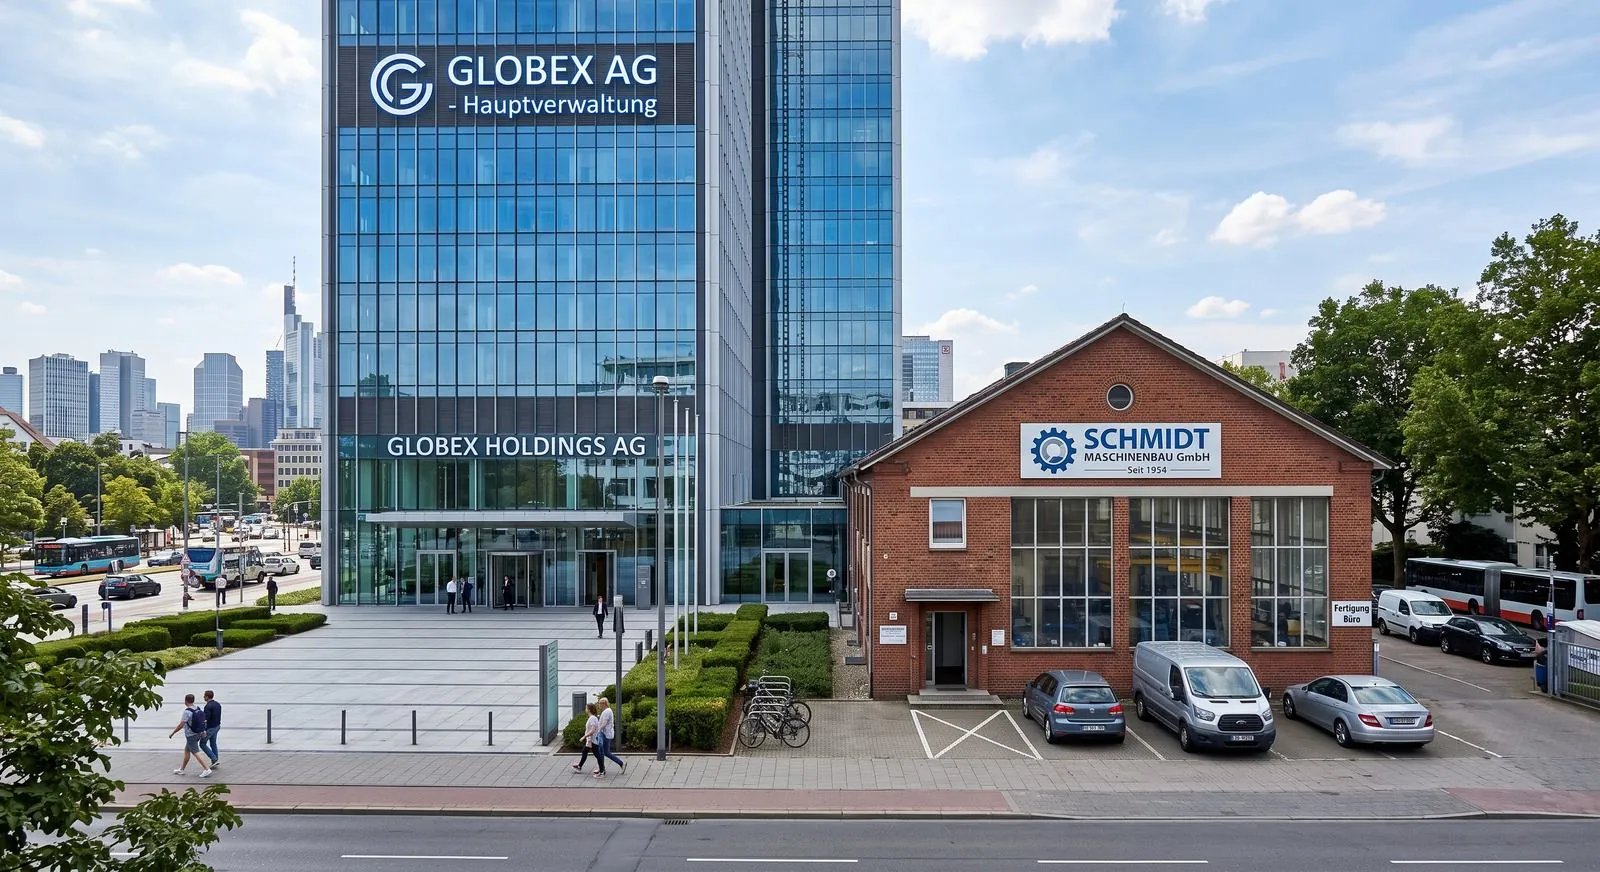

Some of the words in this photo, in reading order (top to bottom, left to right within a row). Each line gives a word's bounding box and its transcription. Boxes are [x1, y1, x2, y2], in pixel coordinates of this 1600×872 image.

[448, 55, 594, 86] GLOBEX
[604, 55, 657, 85] AG
[464, 94, 657, 118] Hauptverwaltung
[387, 436, 478, 456] GLOBEX
[486, 436, 606, 456] HOLDINGS
[613, 436, 646, 456] AG
[1084, 428, 1210, 449] SCHMIDT
[1084, 453, 1173, 462] MASCHINENBAU
[1177, 453, 1210, 462] GmbH
[1127, 466, 1144, 474] Seit
[1147, 466, 1167, 474] 1954
[1334, 604, 1370, 614] Fertigung
[1343, 615, 1361, 623] Büro
